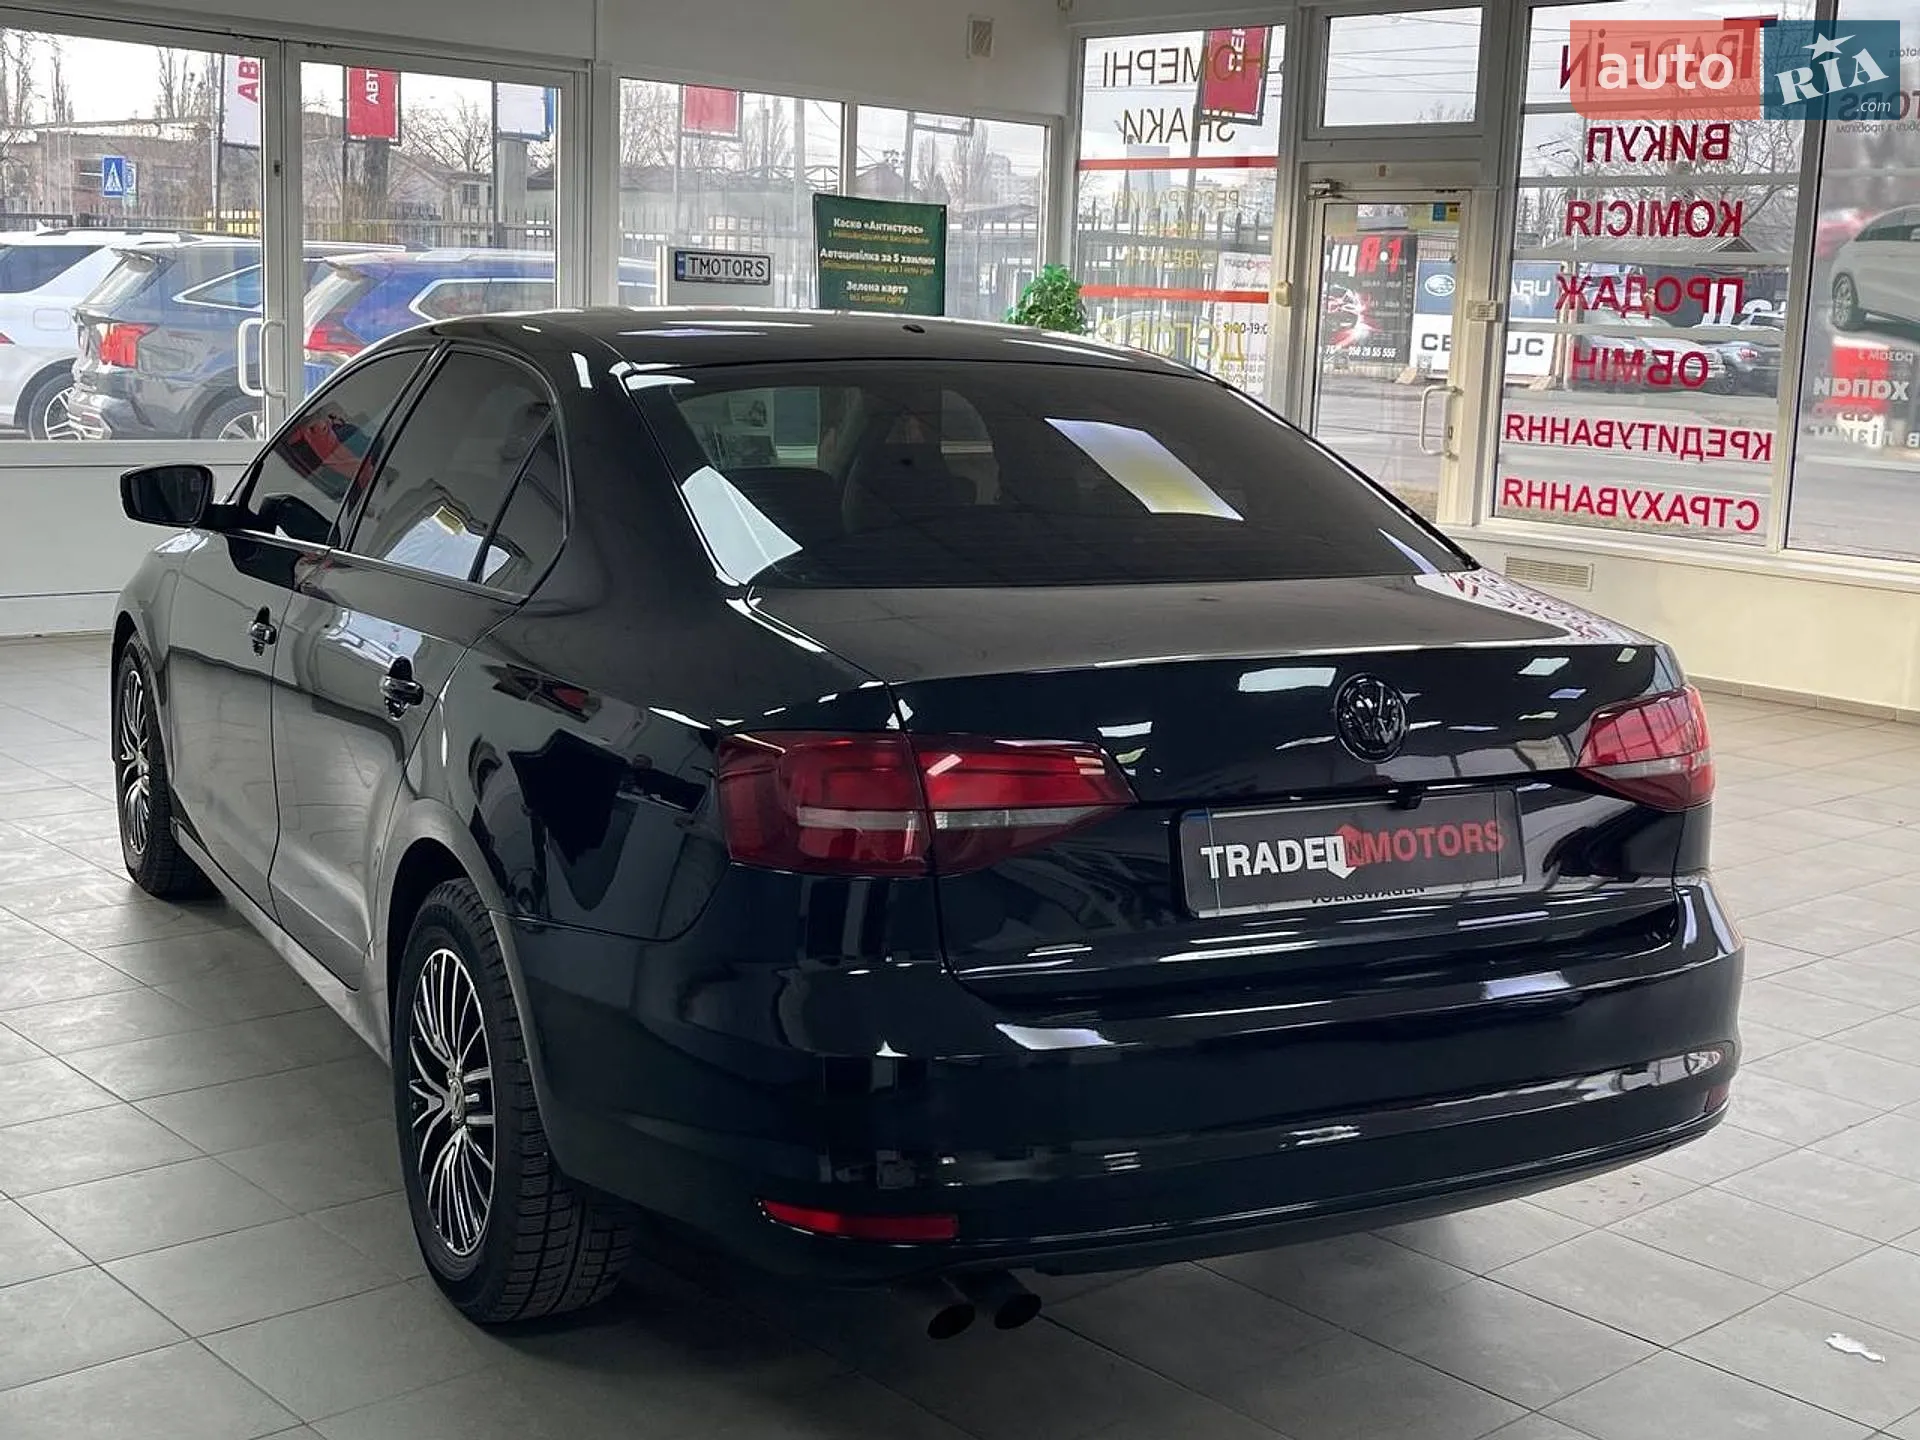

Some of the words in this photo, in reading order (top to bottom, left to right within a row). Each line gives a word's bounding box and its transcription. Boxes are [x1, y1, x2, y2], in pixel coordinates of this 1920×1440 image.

[237, 55, 259, 104] АВ
[833, 217, 862, 229] Каско
[688, 256, 765, 278] TMOTORS
